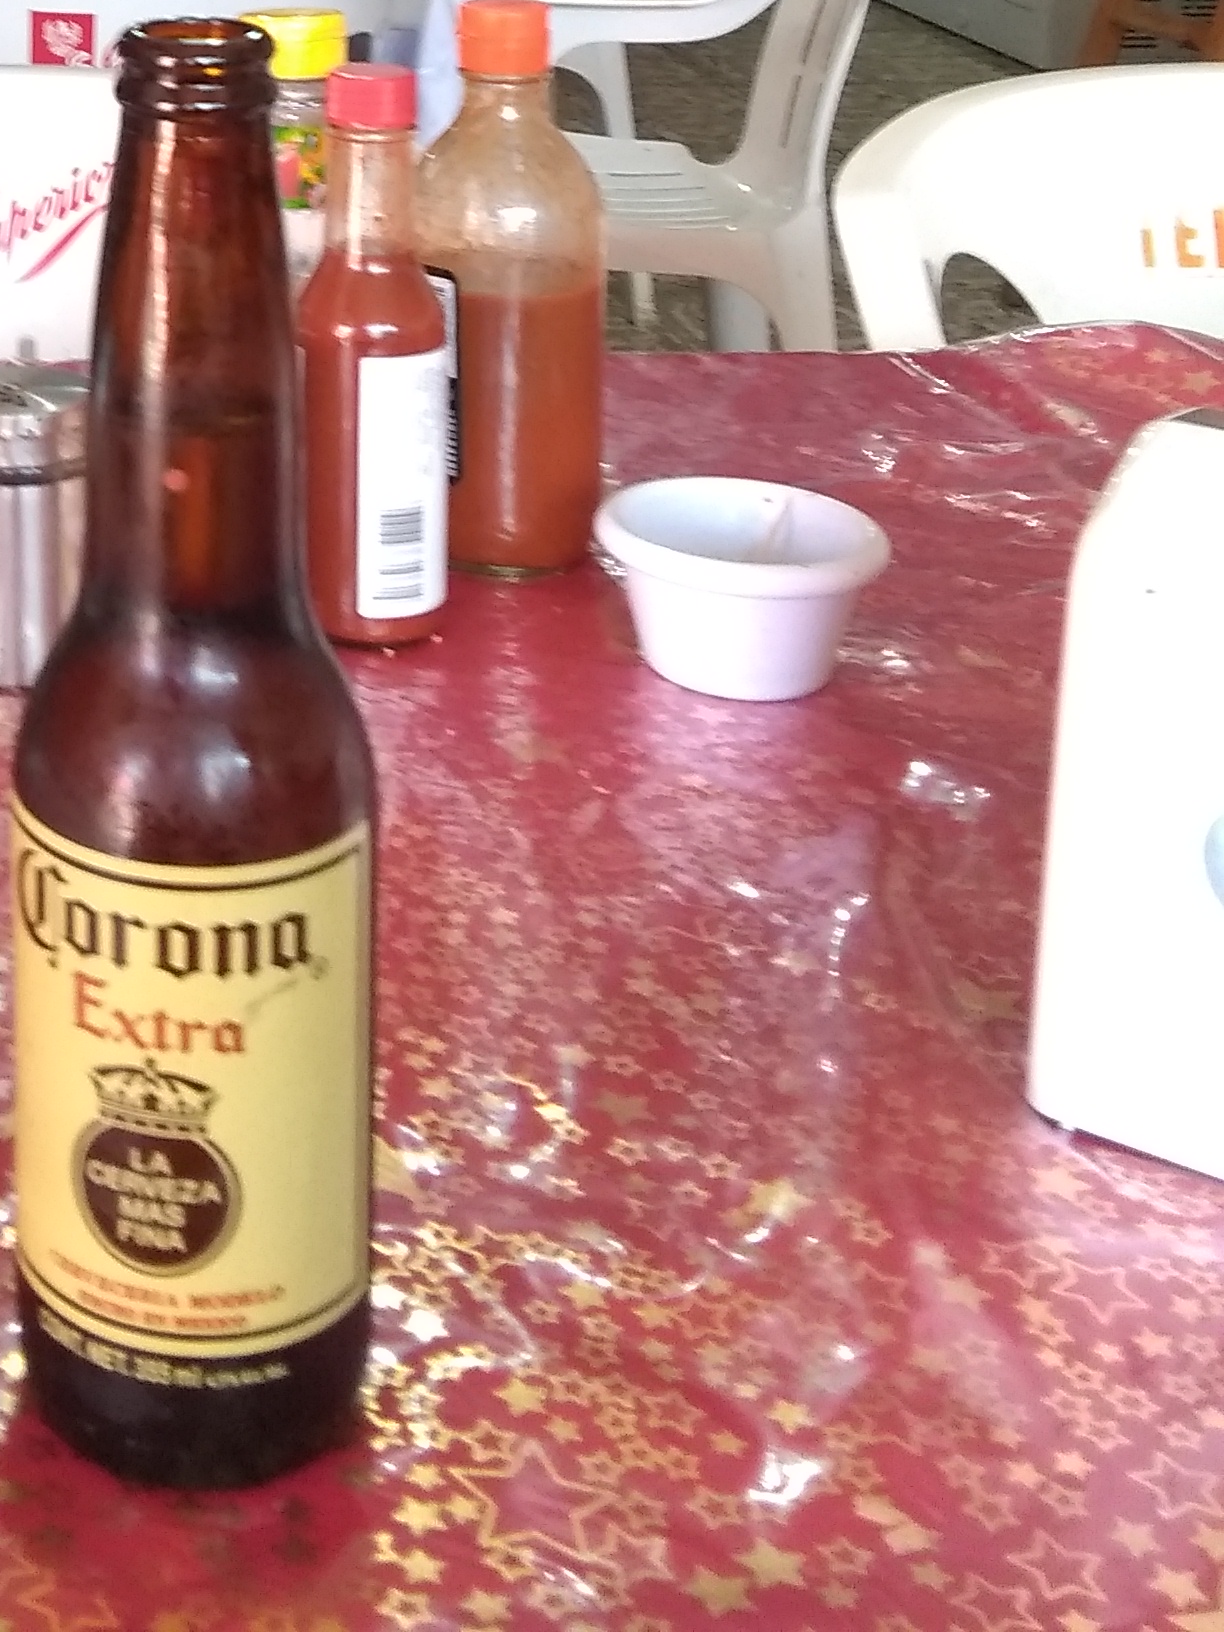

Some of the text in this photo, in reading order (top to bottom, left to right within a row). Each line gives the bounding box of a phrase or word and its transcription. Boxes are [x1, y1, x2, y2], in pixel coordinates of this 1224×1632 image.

[17, 848, 311, 979] Corona
[74, 970, 246, 1053] Extra
[128, 1146, 174, 1176] LA
[115, 1217, 189, 1253] FINA
